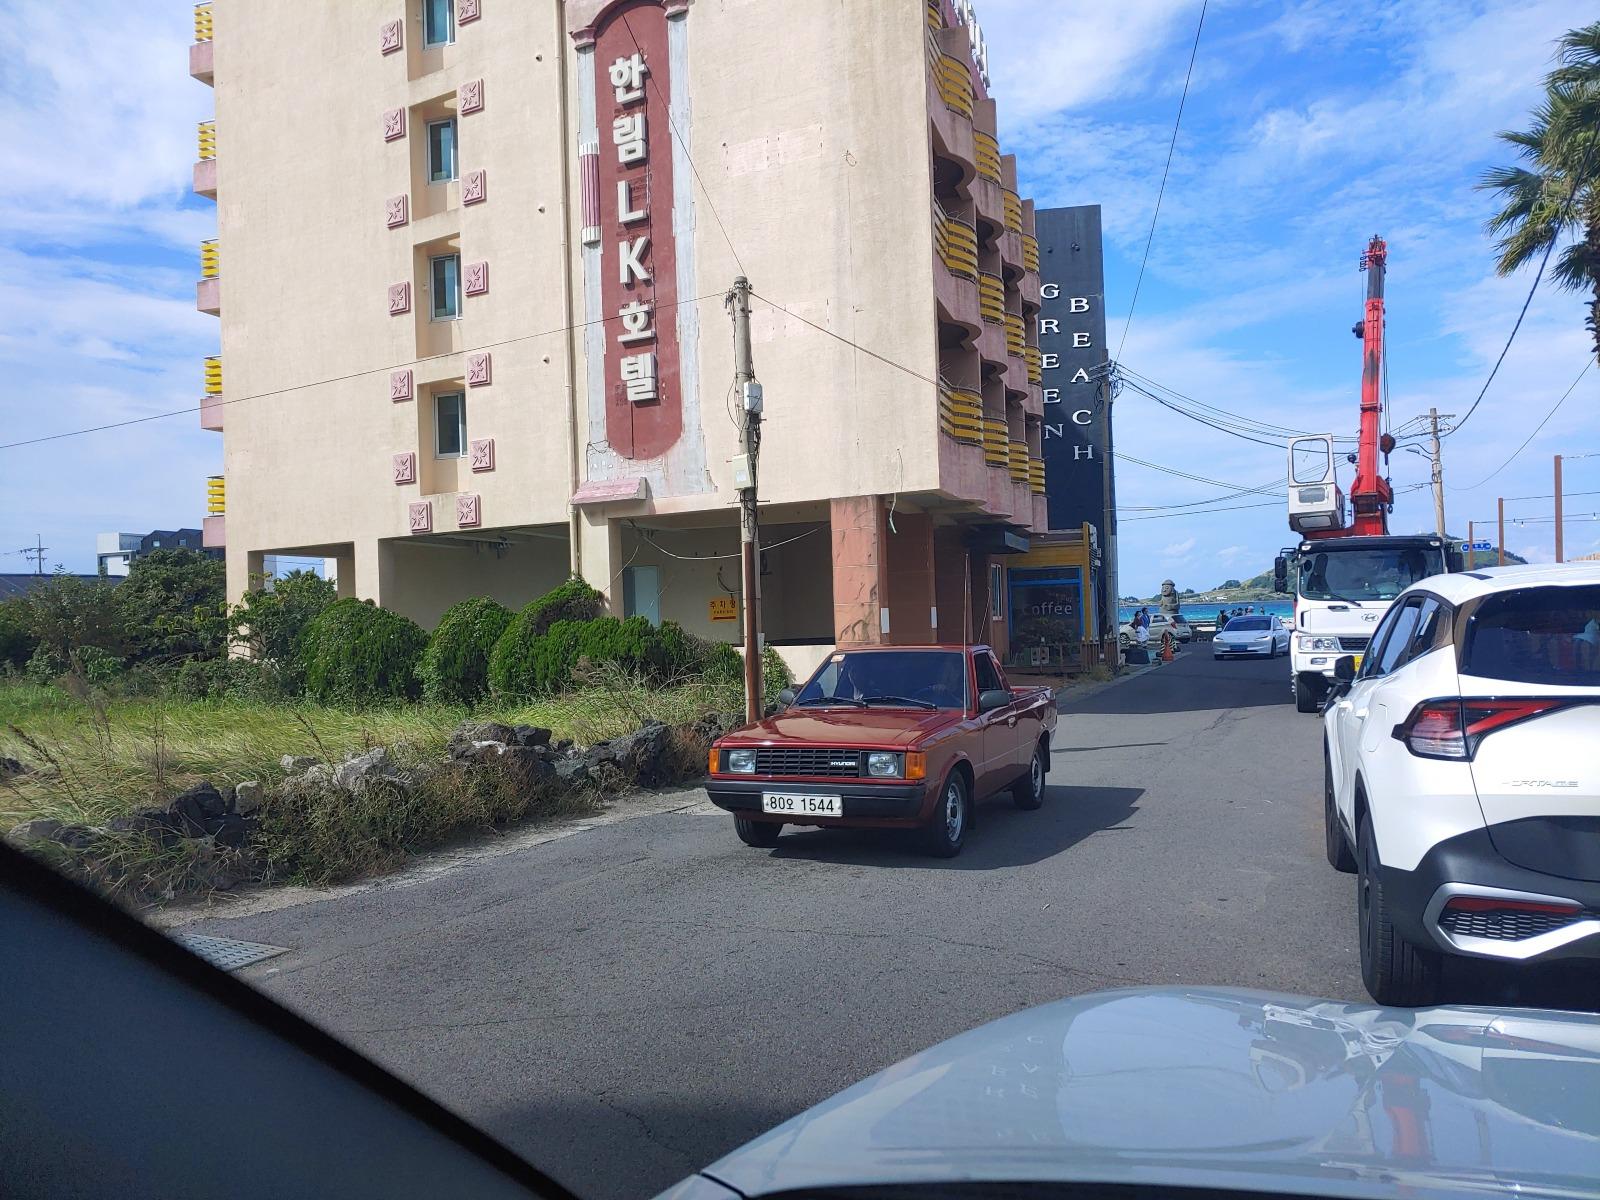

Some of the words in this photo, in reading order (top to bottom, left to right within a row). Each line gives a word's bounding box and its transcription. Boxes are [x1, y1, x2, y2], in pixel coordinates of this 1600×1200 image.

[1040, 283, 1064, 440] GREEN
[1070, 297, 1094, 460] BEACH
[801, 798, 834, 812] 1544
